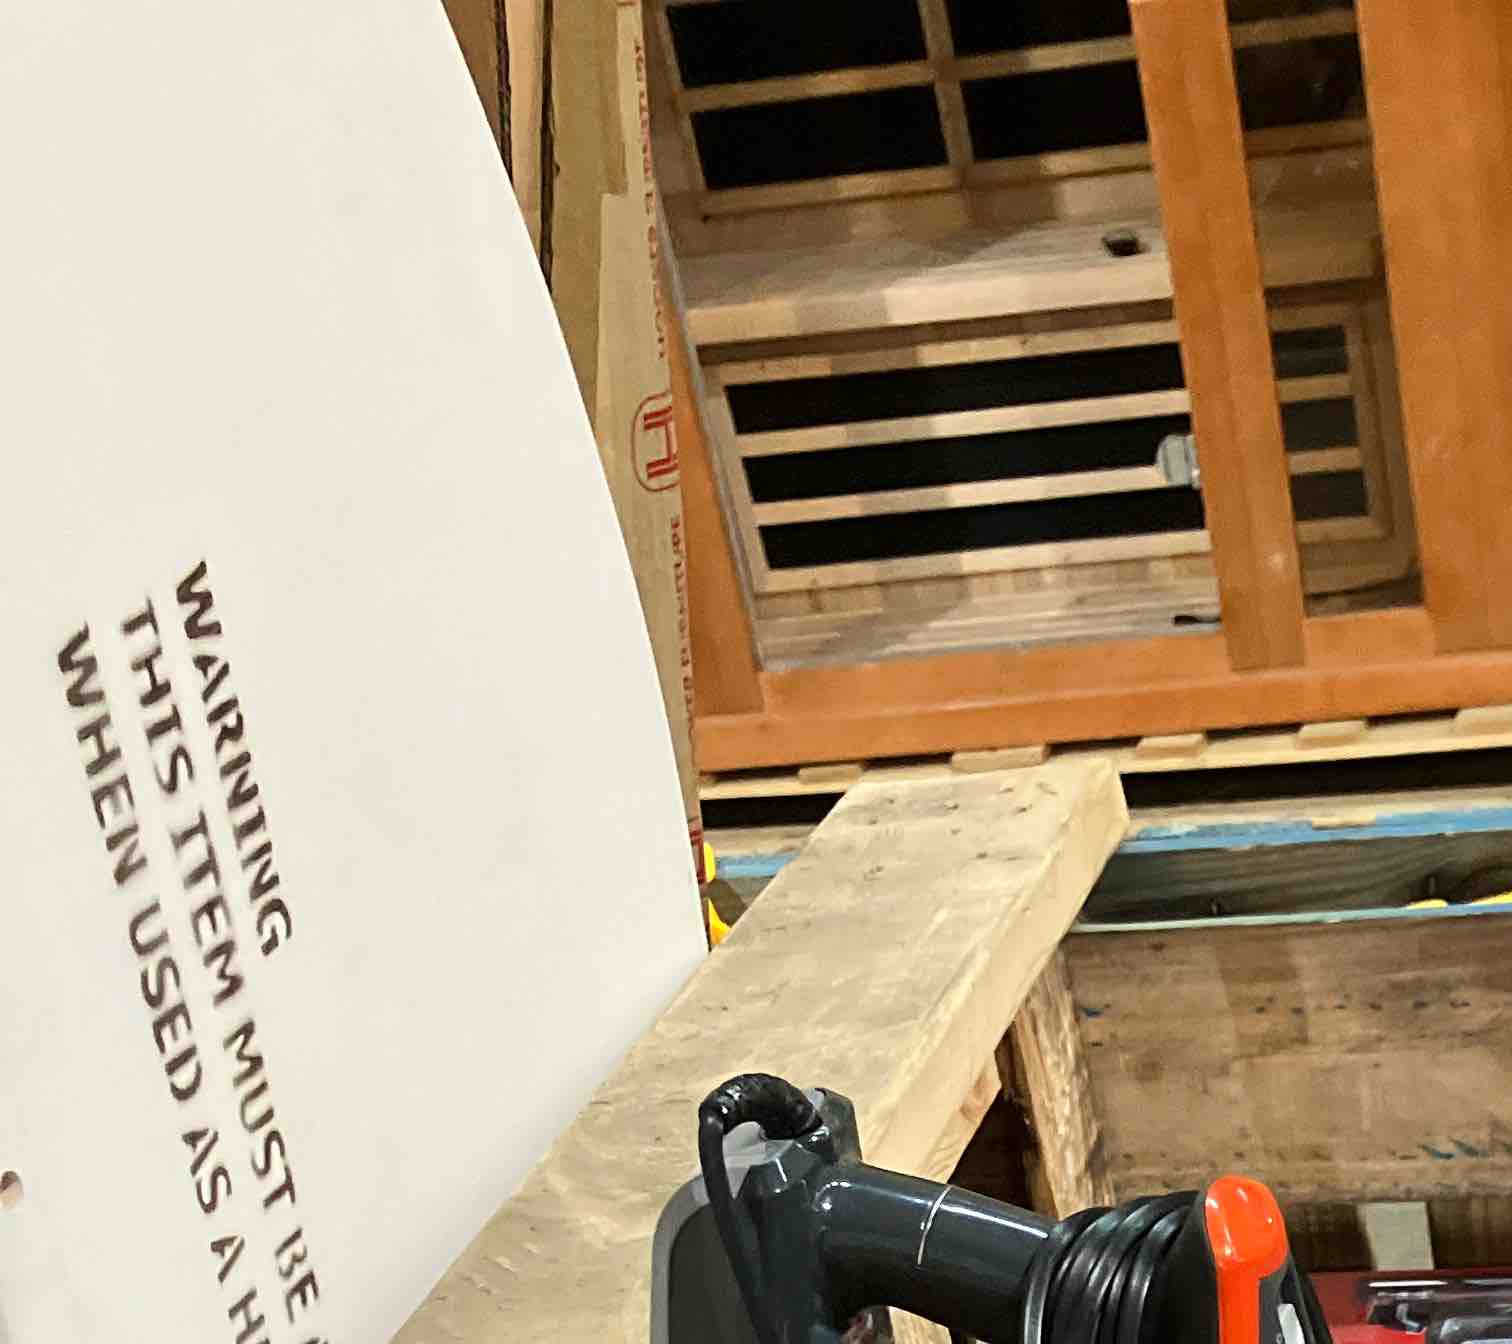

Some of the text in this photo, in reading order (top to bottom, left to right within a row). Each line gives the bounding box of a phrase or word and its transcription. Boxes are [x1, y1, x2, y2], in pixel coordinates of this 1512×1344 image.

[57, 620, 149, 890] WHEN
[127, 898, 205, 1104] USED
[182, 1125, 233, 1216] AS
[210, 1233, 247, 1286] A
[121, 594, 194, 793] THIS
[167, 809, 246, 1009] ITEM
[224, 1018, 297, 1212] MUST
[272, 1228, 322, 1322] BE
[175, 561, 293, 957] WARNING
